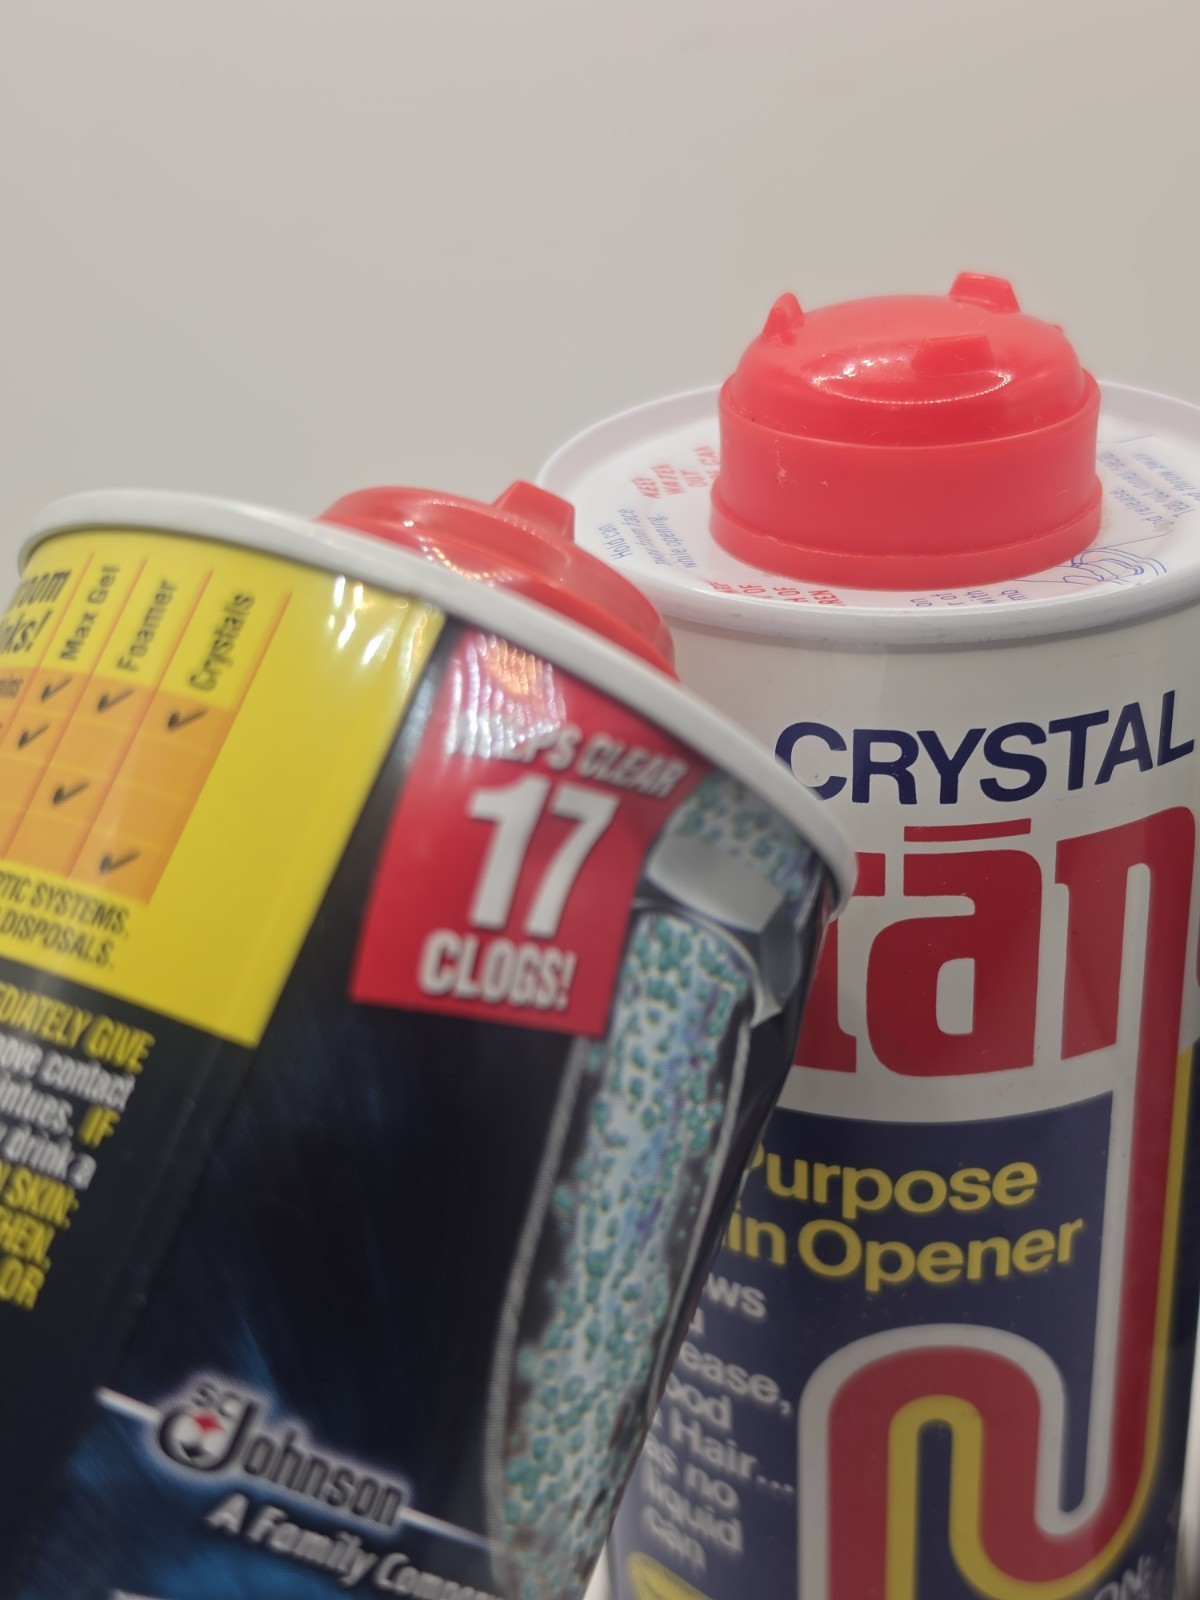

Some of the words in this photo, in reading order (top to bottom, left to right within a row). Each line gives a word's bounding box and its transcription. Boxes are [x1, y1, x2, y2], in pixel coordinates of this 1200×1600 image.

[599, 523, 620, 540] can
[604, 538, 633, 560] Hold
[672, 547, 698, 569] while
[58, 612, 97, 660] Max
[87, 565, 119, 604] Gel
[117, 578, 177, 672] Foamer
[807, 589, 846, 606] REN
[189, 591, 255, 692] Crystals
[576, 731, 688, 798] CLEAR
[775, 690, 1195, 805] CRYSTAL
[467, 774, 620, 940] 17
[416, 929, 578, 1011] CLOGS!
[40, 1050, 136, 1112] contact
[85, 1014, 155, 1075] GIVE
[79, 1103, 121, 1147] IF
[722, 1200, 787, 1267] in
[798, 1218, 1084, 1293] Opener
[160, 1402, 403, 1529] Johnson
[684, 1462, 741, 1511] no
[204, 1492, 250, 1538] A
[248, 1505, 379, 1588] Family
